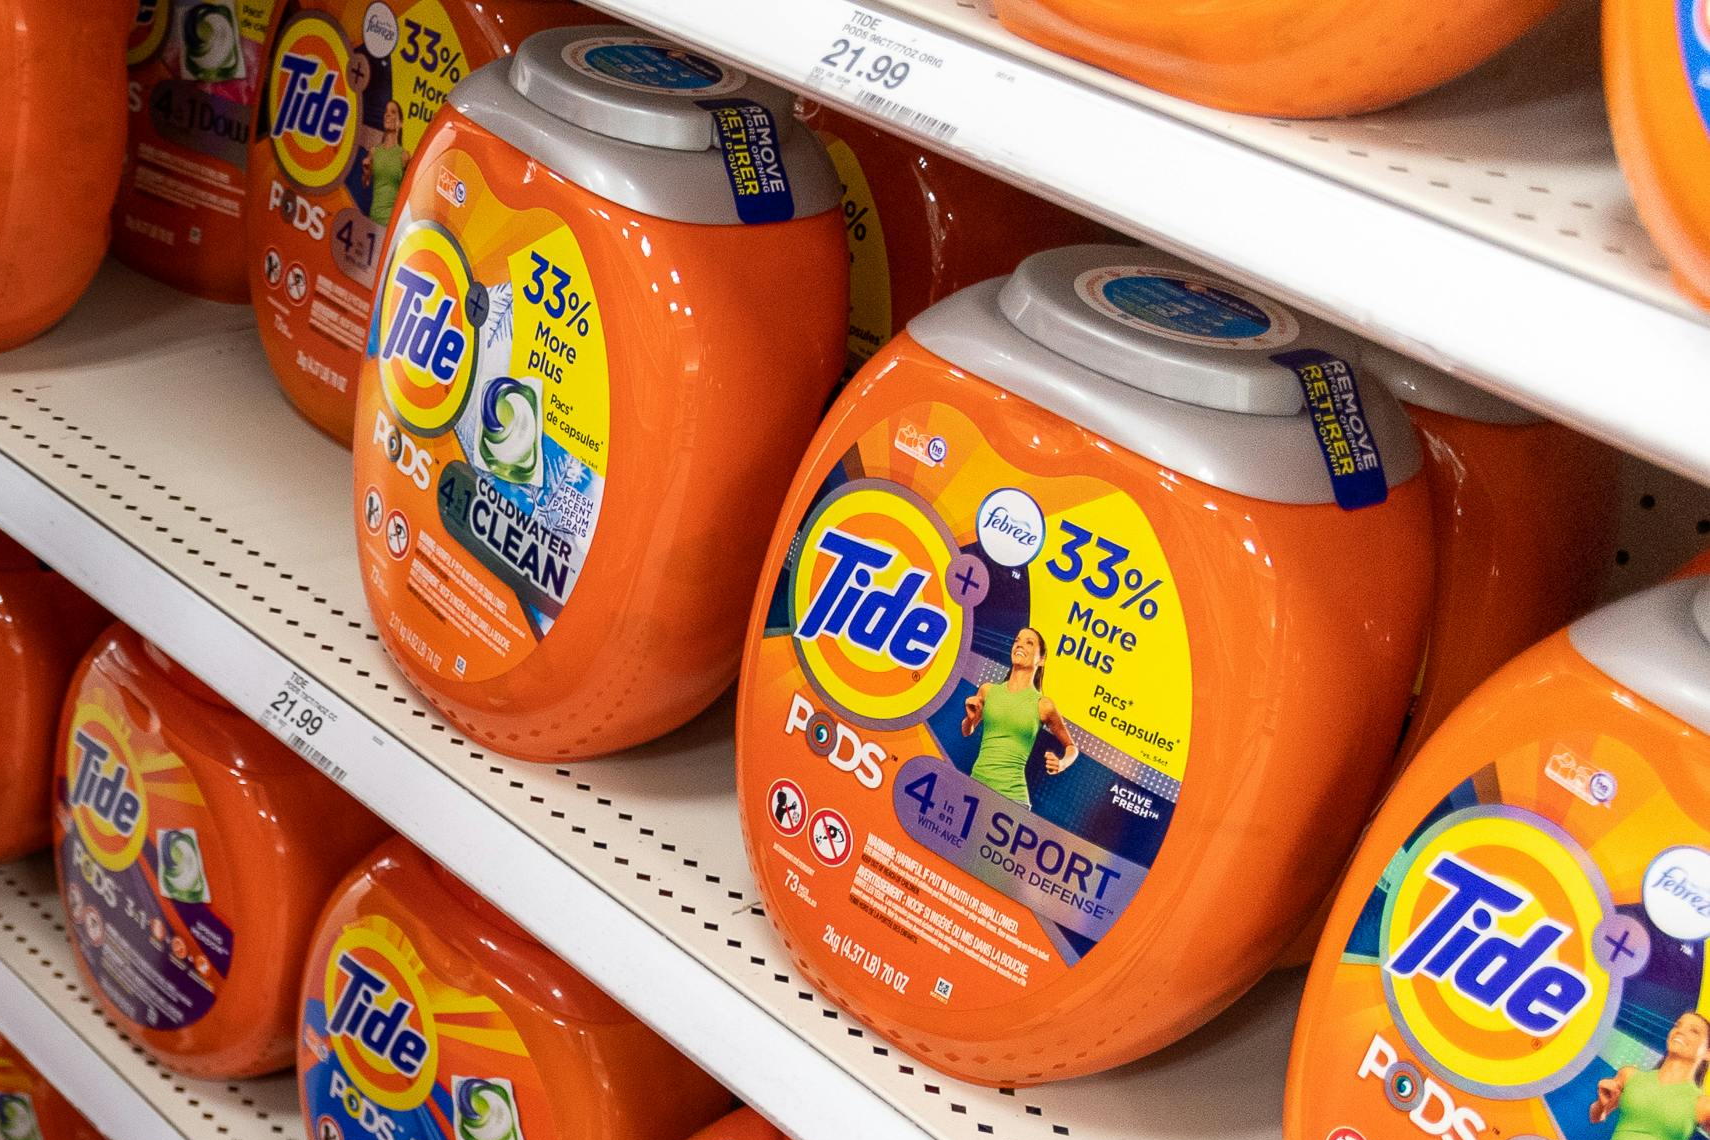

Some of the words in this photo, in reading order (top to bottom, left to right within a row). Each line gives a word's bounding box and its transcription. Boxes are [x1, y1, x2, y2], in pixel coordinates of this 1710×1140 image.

[400, 19, 460, 83] 33%
[842, 24, 867, 39] PODS
[919, 53, 944, 68] ORIG
[851, 10, 882, 31] TIDE
[821, 38, 910, 89] 21.99
[270, 53, 350, 146] Tide
[723, 107, 760, 196] RETIRER
[750, 105, 786, 192] REMOVE
[268, 180, 326, 241] PODS
[383, 263, 466, 385] Tide
[522, 251, 591, 338] 33%
[527, 347, 565, 385] plus
[534, 320, 577, 365] More
[1304, 364, 1355, 476] RETIRER
[1326, 360, 1378, 471] REMOVE
[1340, 415, 1364, 472] OPENING
[373, 409, 430, 492] PODS
[478, 479, 572, 562] COLDWATER
[553, 500, 590, 529] PARFUM
[560, 516, 587, 538] FRAIS
[563, 496, 592, 518] SCENT
[564, 486, 594, 509] FRESH
[985, 505, 1037, 547] febreze
[471, 500, 570, 599] CLEAN
[1046, 520, 1163, 622] 33%
[796, 528, 949, 669] Tide
[1068, 600, 1137, 653] More
[1056, 631, 1115, 675] plus
[271, 691, 323, 735] 21.99
[785, 693, 887, 789] PODS
[1089, 703, 1111, 724] de
[69, 730, 140, 836] Tide
[1110, 783, 1153, 810] ACTIVE
[903, 772, 938, 815] 4
[986, 811, 1120, 900] SPORT
[784, 869, 800, 892] 73
[979, 844, 1027, 886] ODOR
[1028, 872, 1106, 921] DEFENSE
[822, 924, 840, 953] 2kg
[841, 935, 865, 965] (4.37
[863, 952, 881, 978] LB)
[880, 962, 894, 985] 70
[894, 972, 910, 994] OZ
[1385, 853, 1590, 1035] Tide
[327, 951, 427, 1078] Tide
